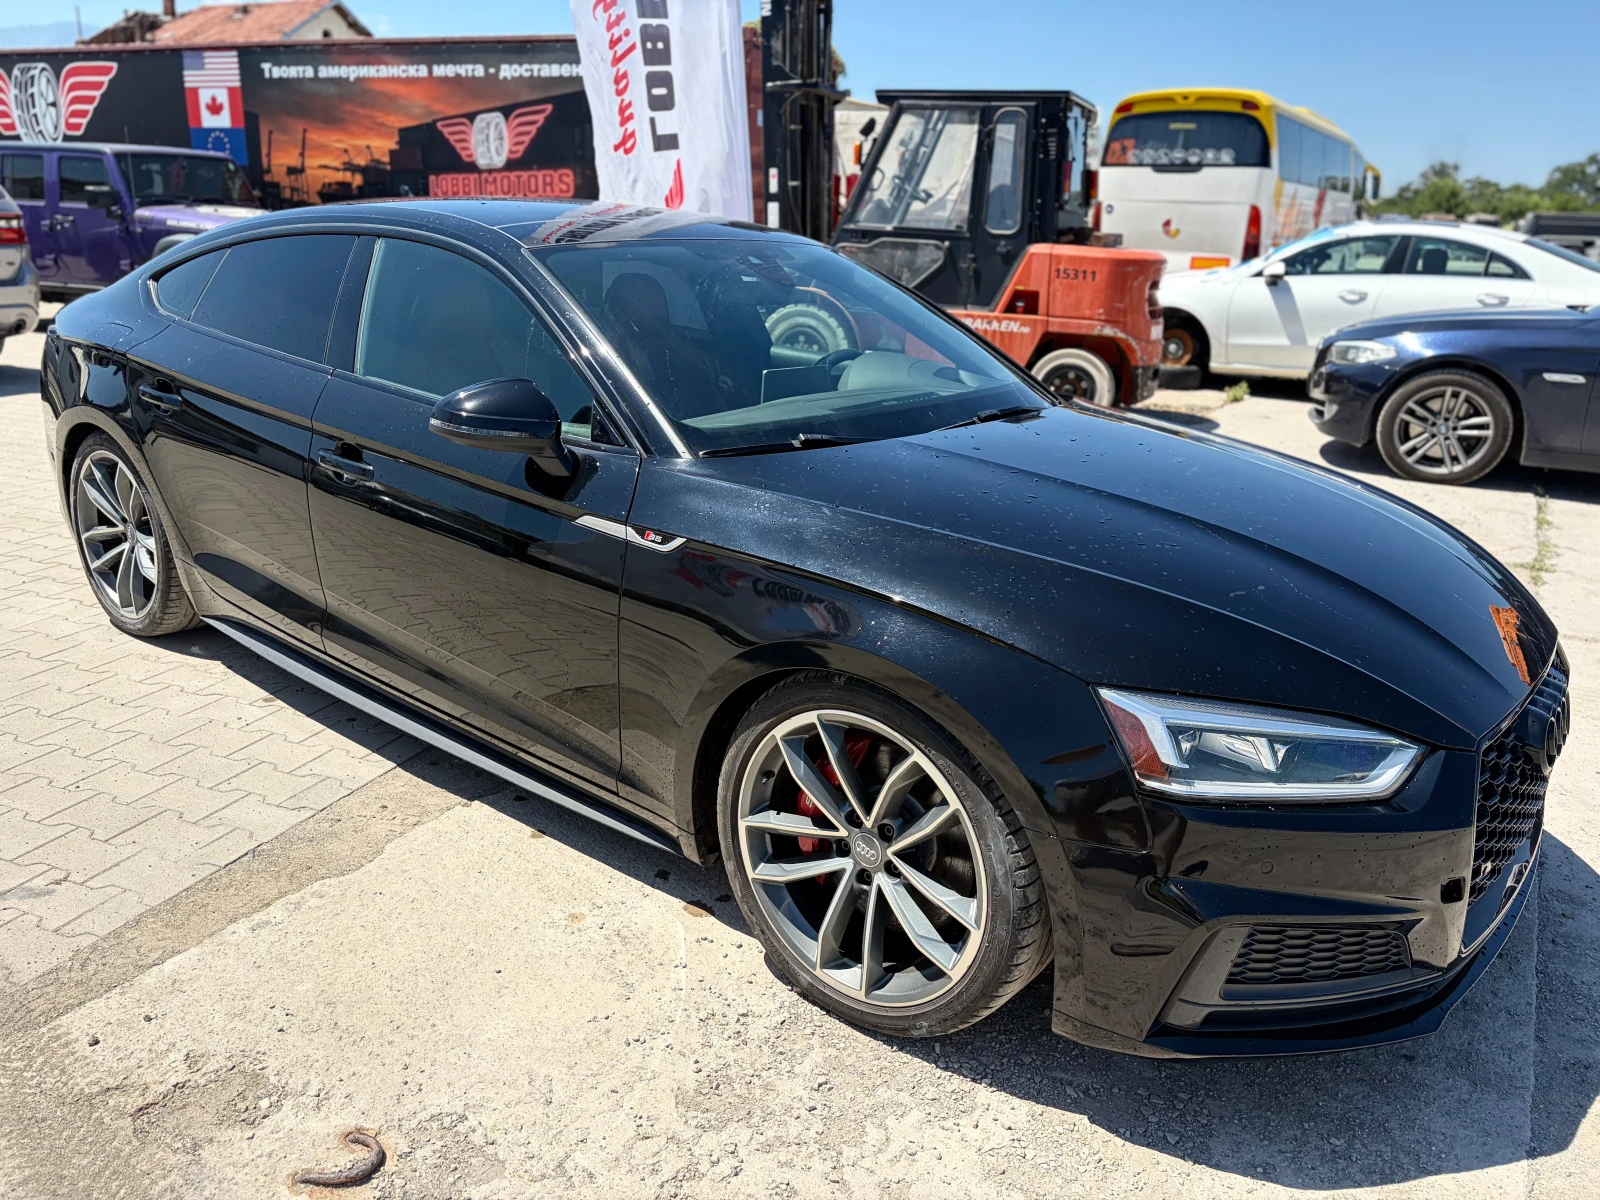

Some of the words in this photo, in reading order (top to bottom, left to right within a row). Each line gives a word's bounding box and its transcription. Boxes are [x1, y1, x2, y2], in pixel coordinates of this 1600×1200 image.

[260, 62, 315, 79] Твоята
[317, 64, 429, 82] американска
[432, 63, 485, 78] мечта
[429, 173, 480, 198] LOBBI
[481, 168, 575, 198] MOTORS
[1054, 268, 1097, 282] 15311
